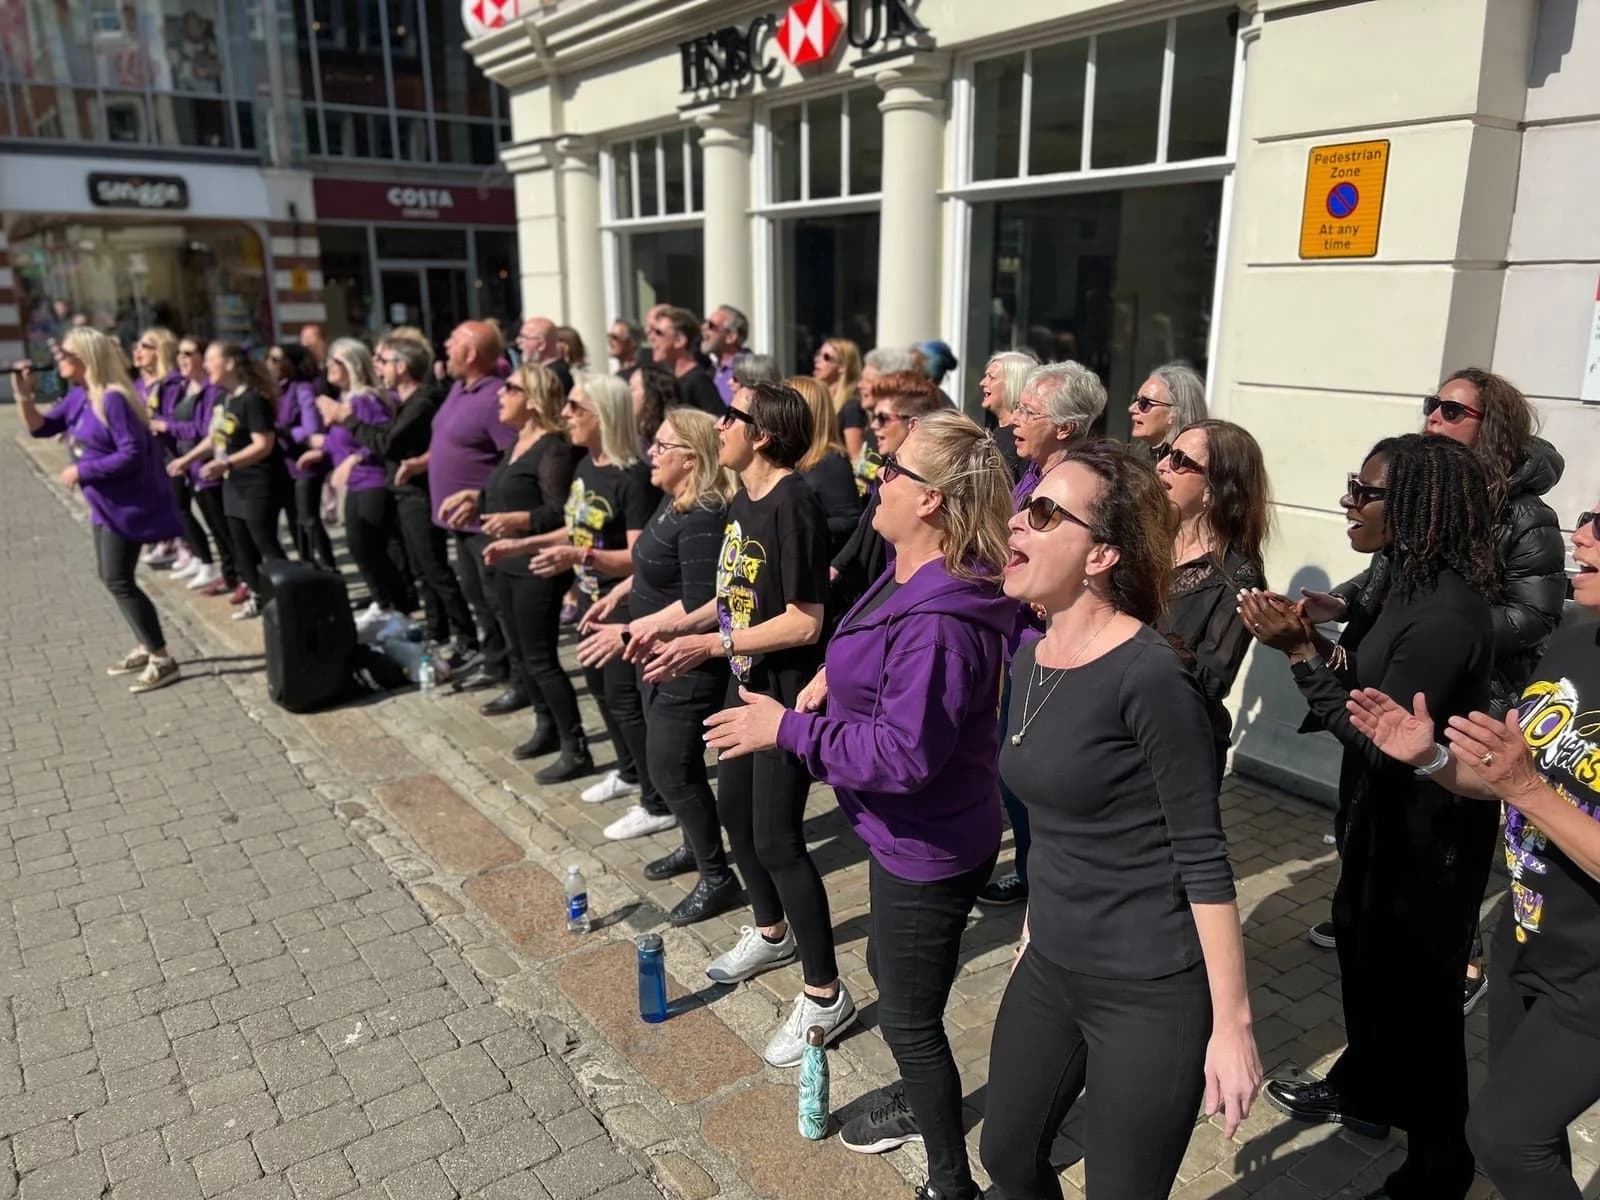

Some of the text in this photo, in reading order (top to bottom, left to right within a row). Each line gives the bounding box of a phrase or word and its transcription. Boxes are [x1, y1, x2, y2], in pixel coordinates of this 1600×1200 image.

[679, 0, 931, 93] HSBC UK
[1314, 150, 1382, 165] Pedestrian
[1330, 166, 1361, 178] Zone
[387, 187, 454, 209] COSTA
[1319, 224, 1360, 236] At any
[1324, 239, 1351, 249] time
